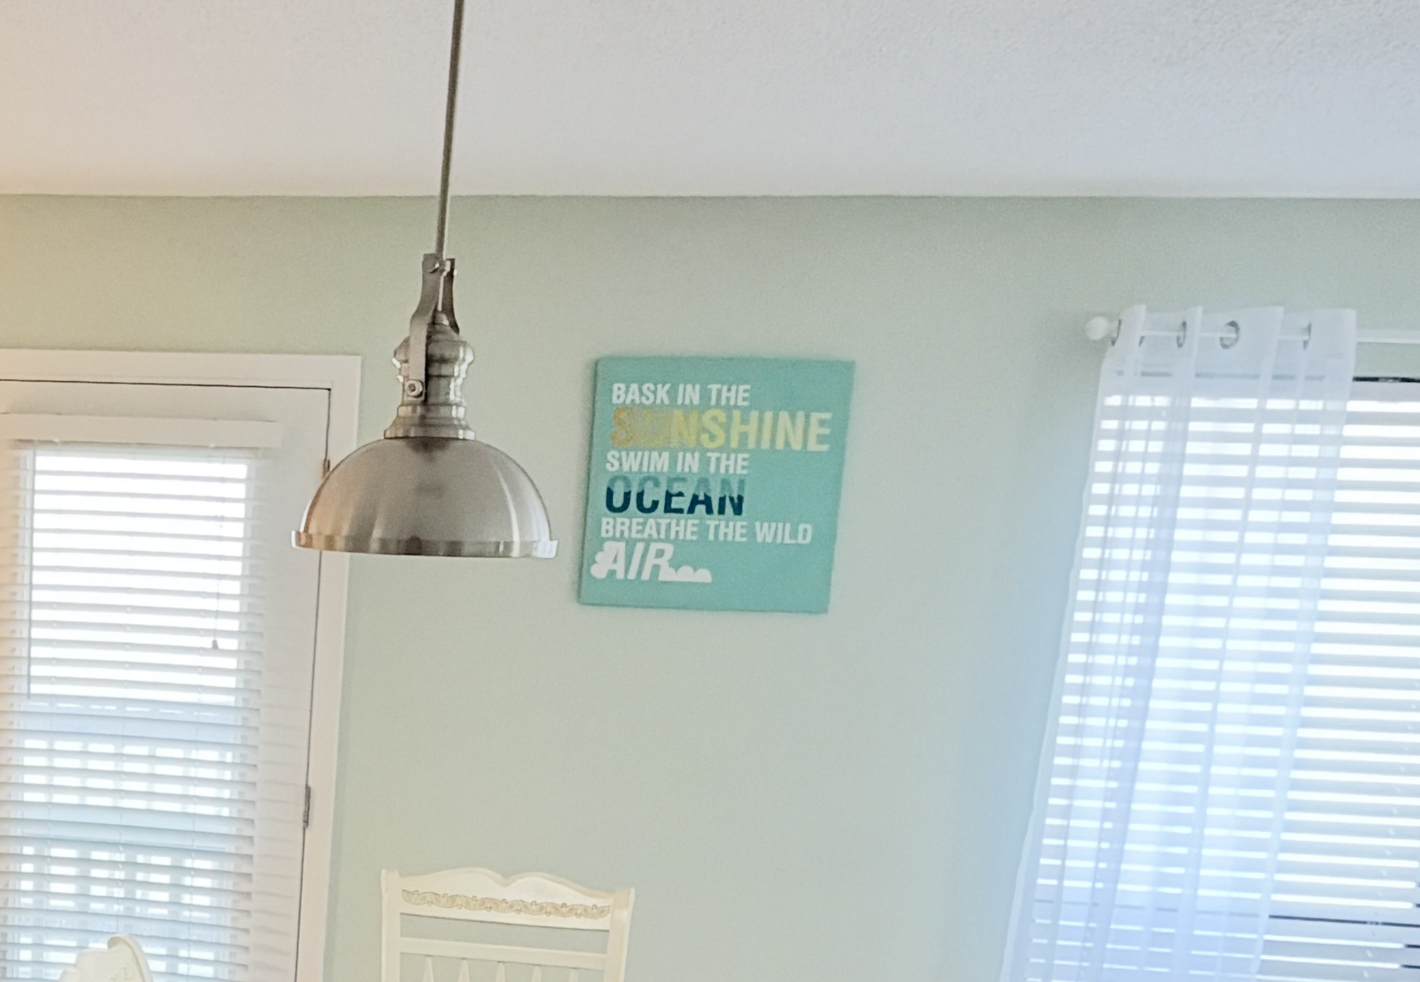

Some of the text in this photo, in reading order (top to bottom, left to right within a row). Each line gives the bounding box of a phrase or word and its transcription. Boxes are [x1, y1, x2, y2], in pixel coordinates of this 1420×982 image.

[611, 383, 751, 406] BASK IN THE
[610, 407, 832, 451] SUNSHINE
[606, 450, 750, 474] SWIM IN THE
[605, 475, 746, 516] OCEAN
[600, 517, 813, 544] BREATHE THE WILD
[593, 541, 682, 582] AIR
